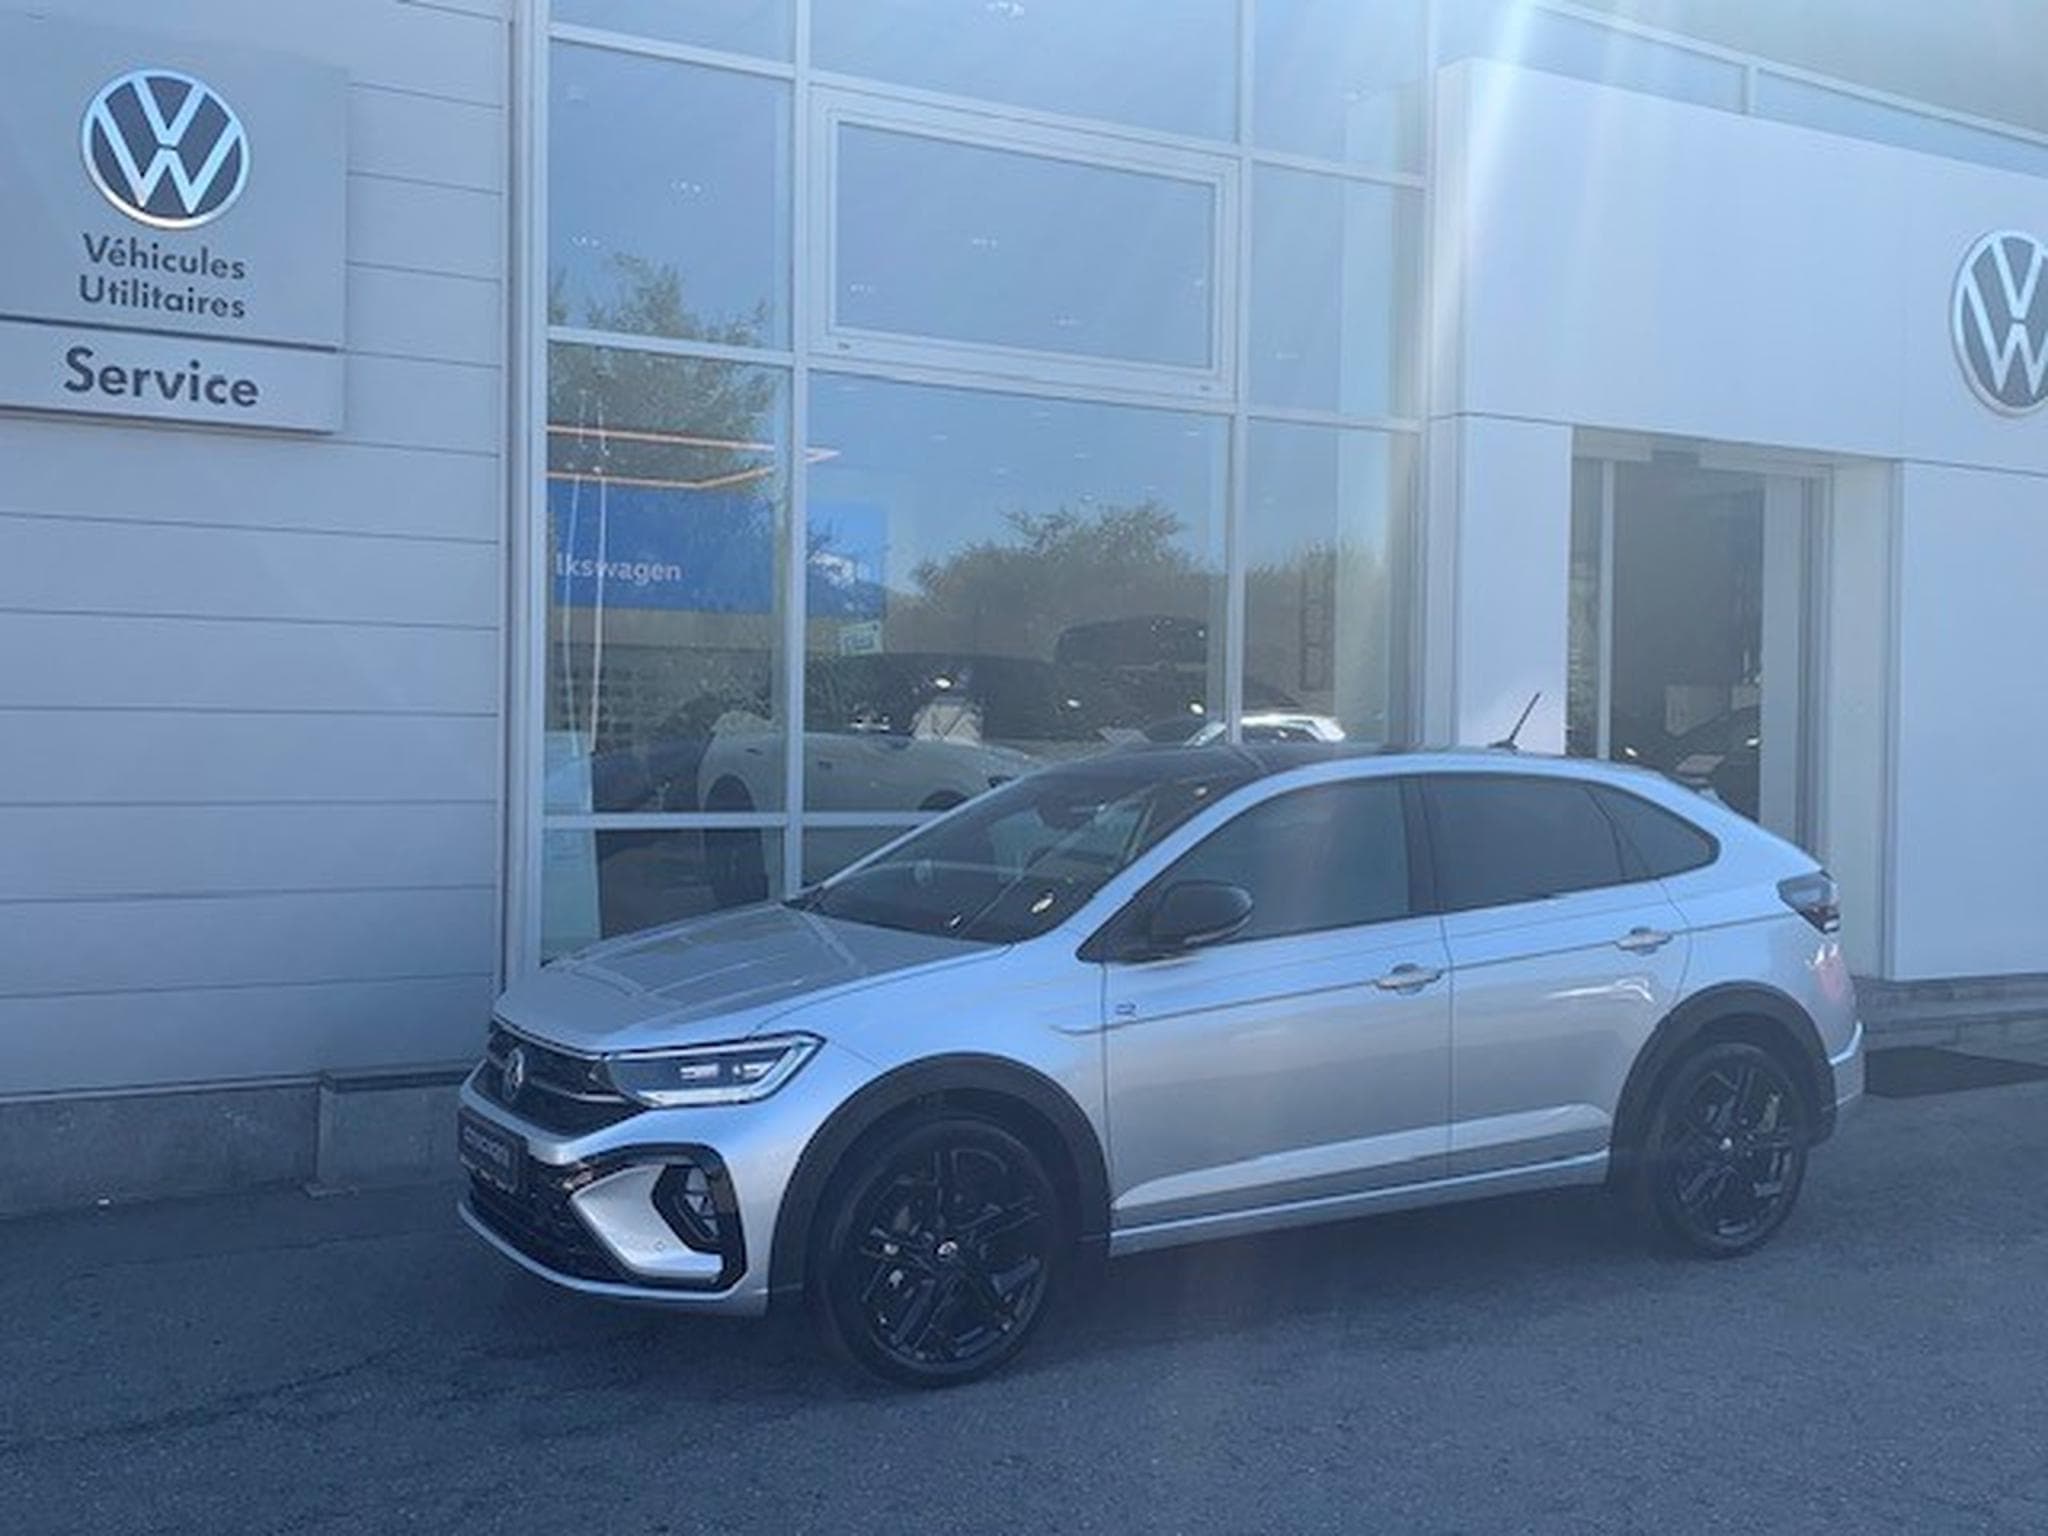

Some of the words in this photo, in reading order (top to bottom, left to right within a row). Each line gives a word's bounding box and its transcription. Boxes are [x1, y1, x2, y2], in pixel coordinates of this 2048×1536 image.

[82, 232, 246, 280] Véhicules
[79, 274, 246, 319] Utilitaires
[63, 346, 260, 408] Service
